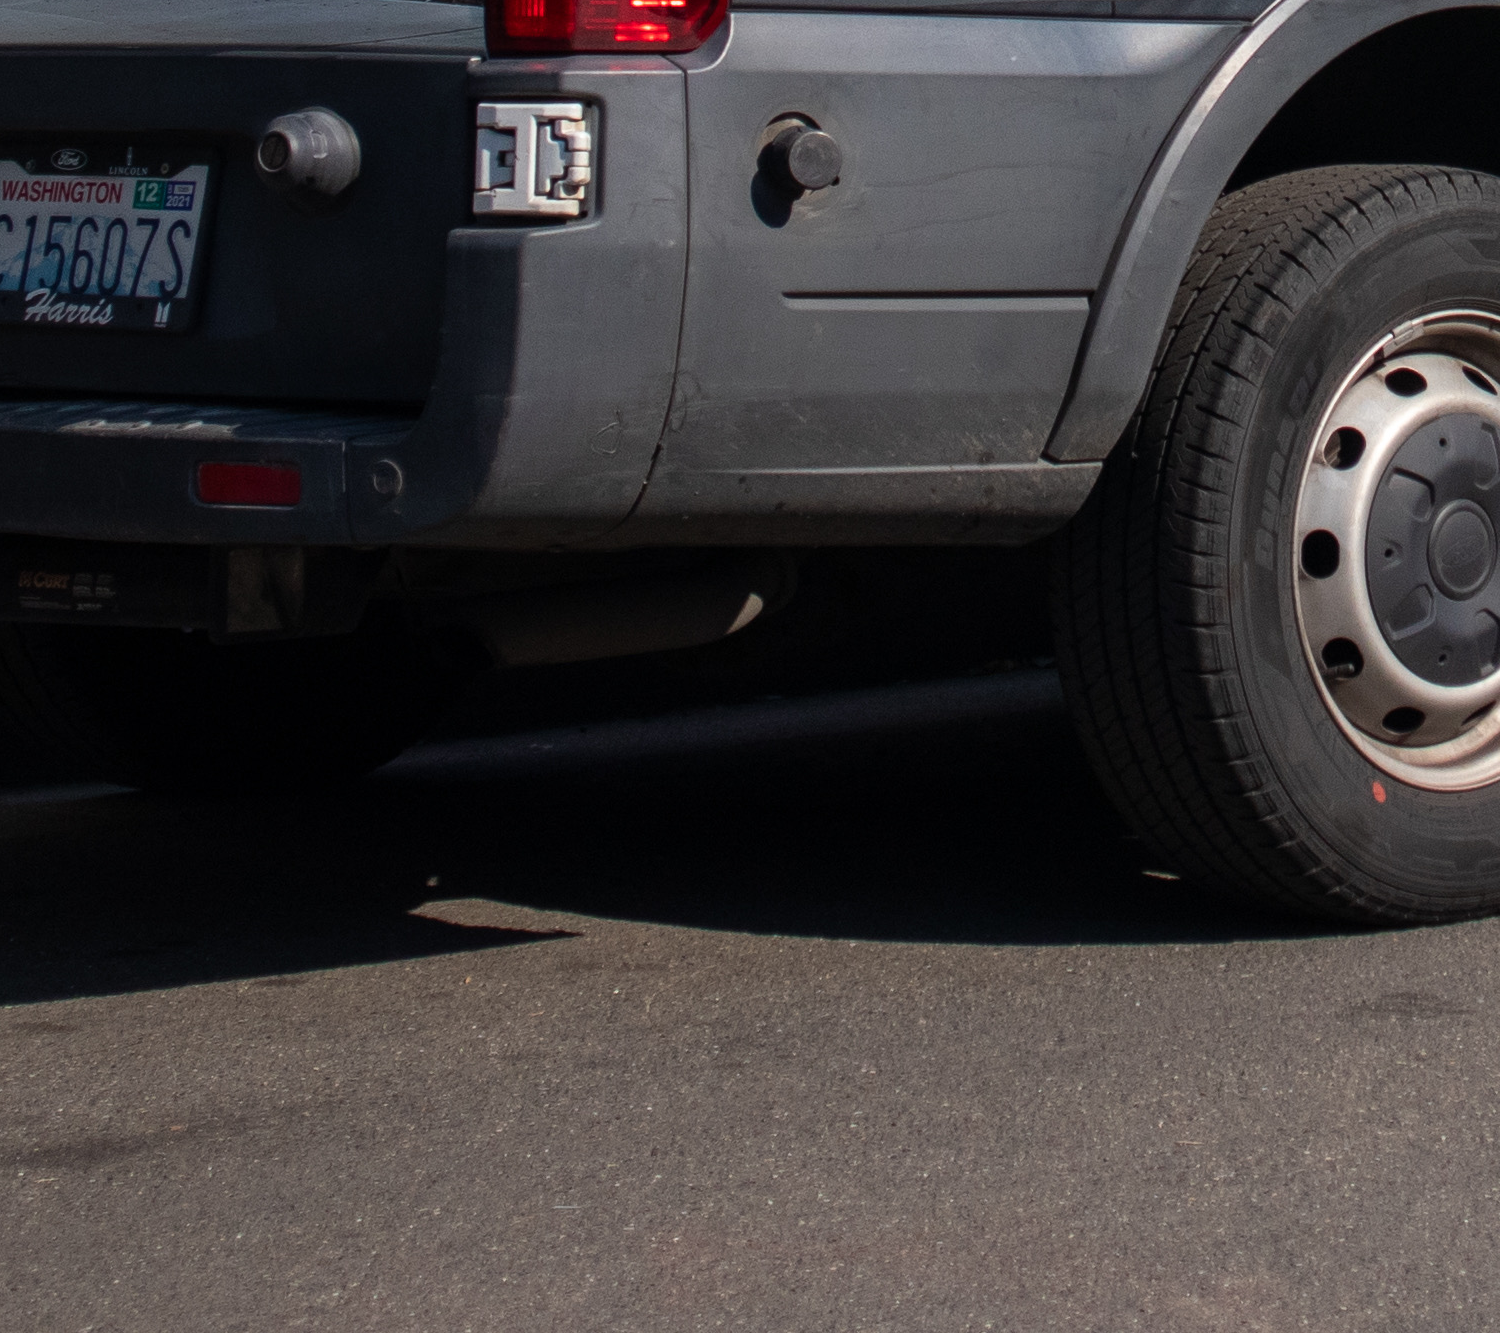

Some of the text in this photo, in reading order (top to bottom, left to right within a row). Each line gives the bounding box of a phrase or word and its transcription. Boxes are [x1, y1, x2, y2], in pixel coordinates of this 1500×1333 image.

[108, 166, 149, 176] LINCOLN
[2, 180, 123, 204] WASHINGTON
[137, 182, 159, 203] 12
[166, 195, 191, 207] 2021
[23, 288, 115, 326] Harris
